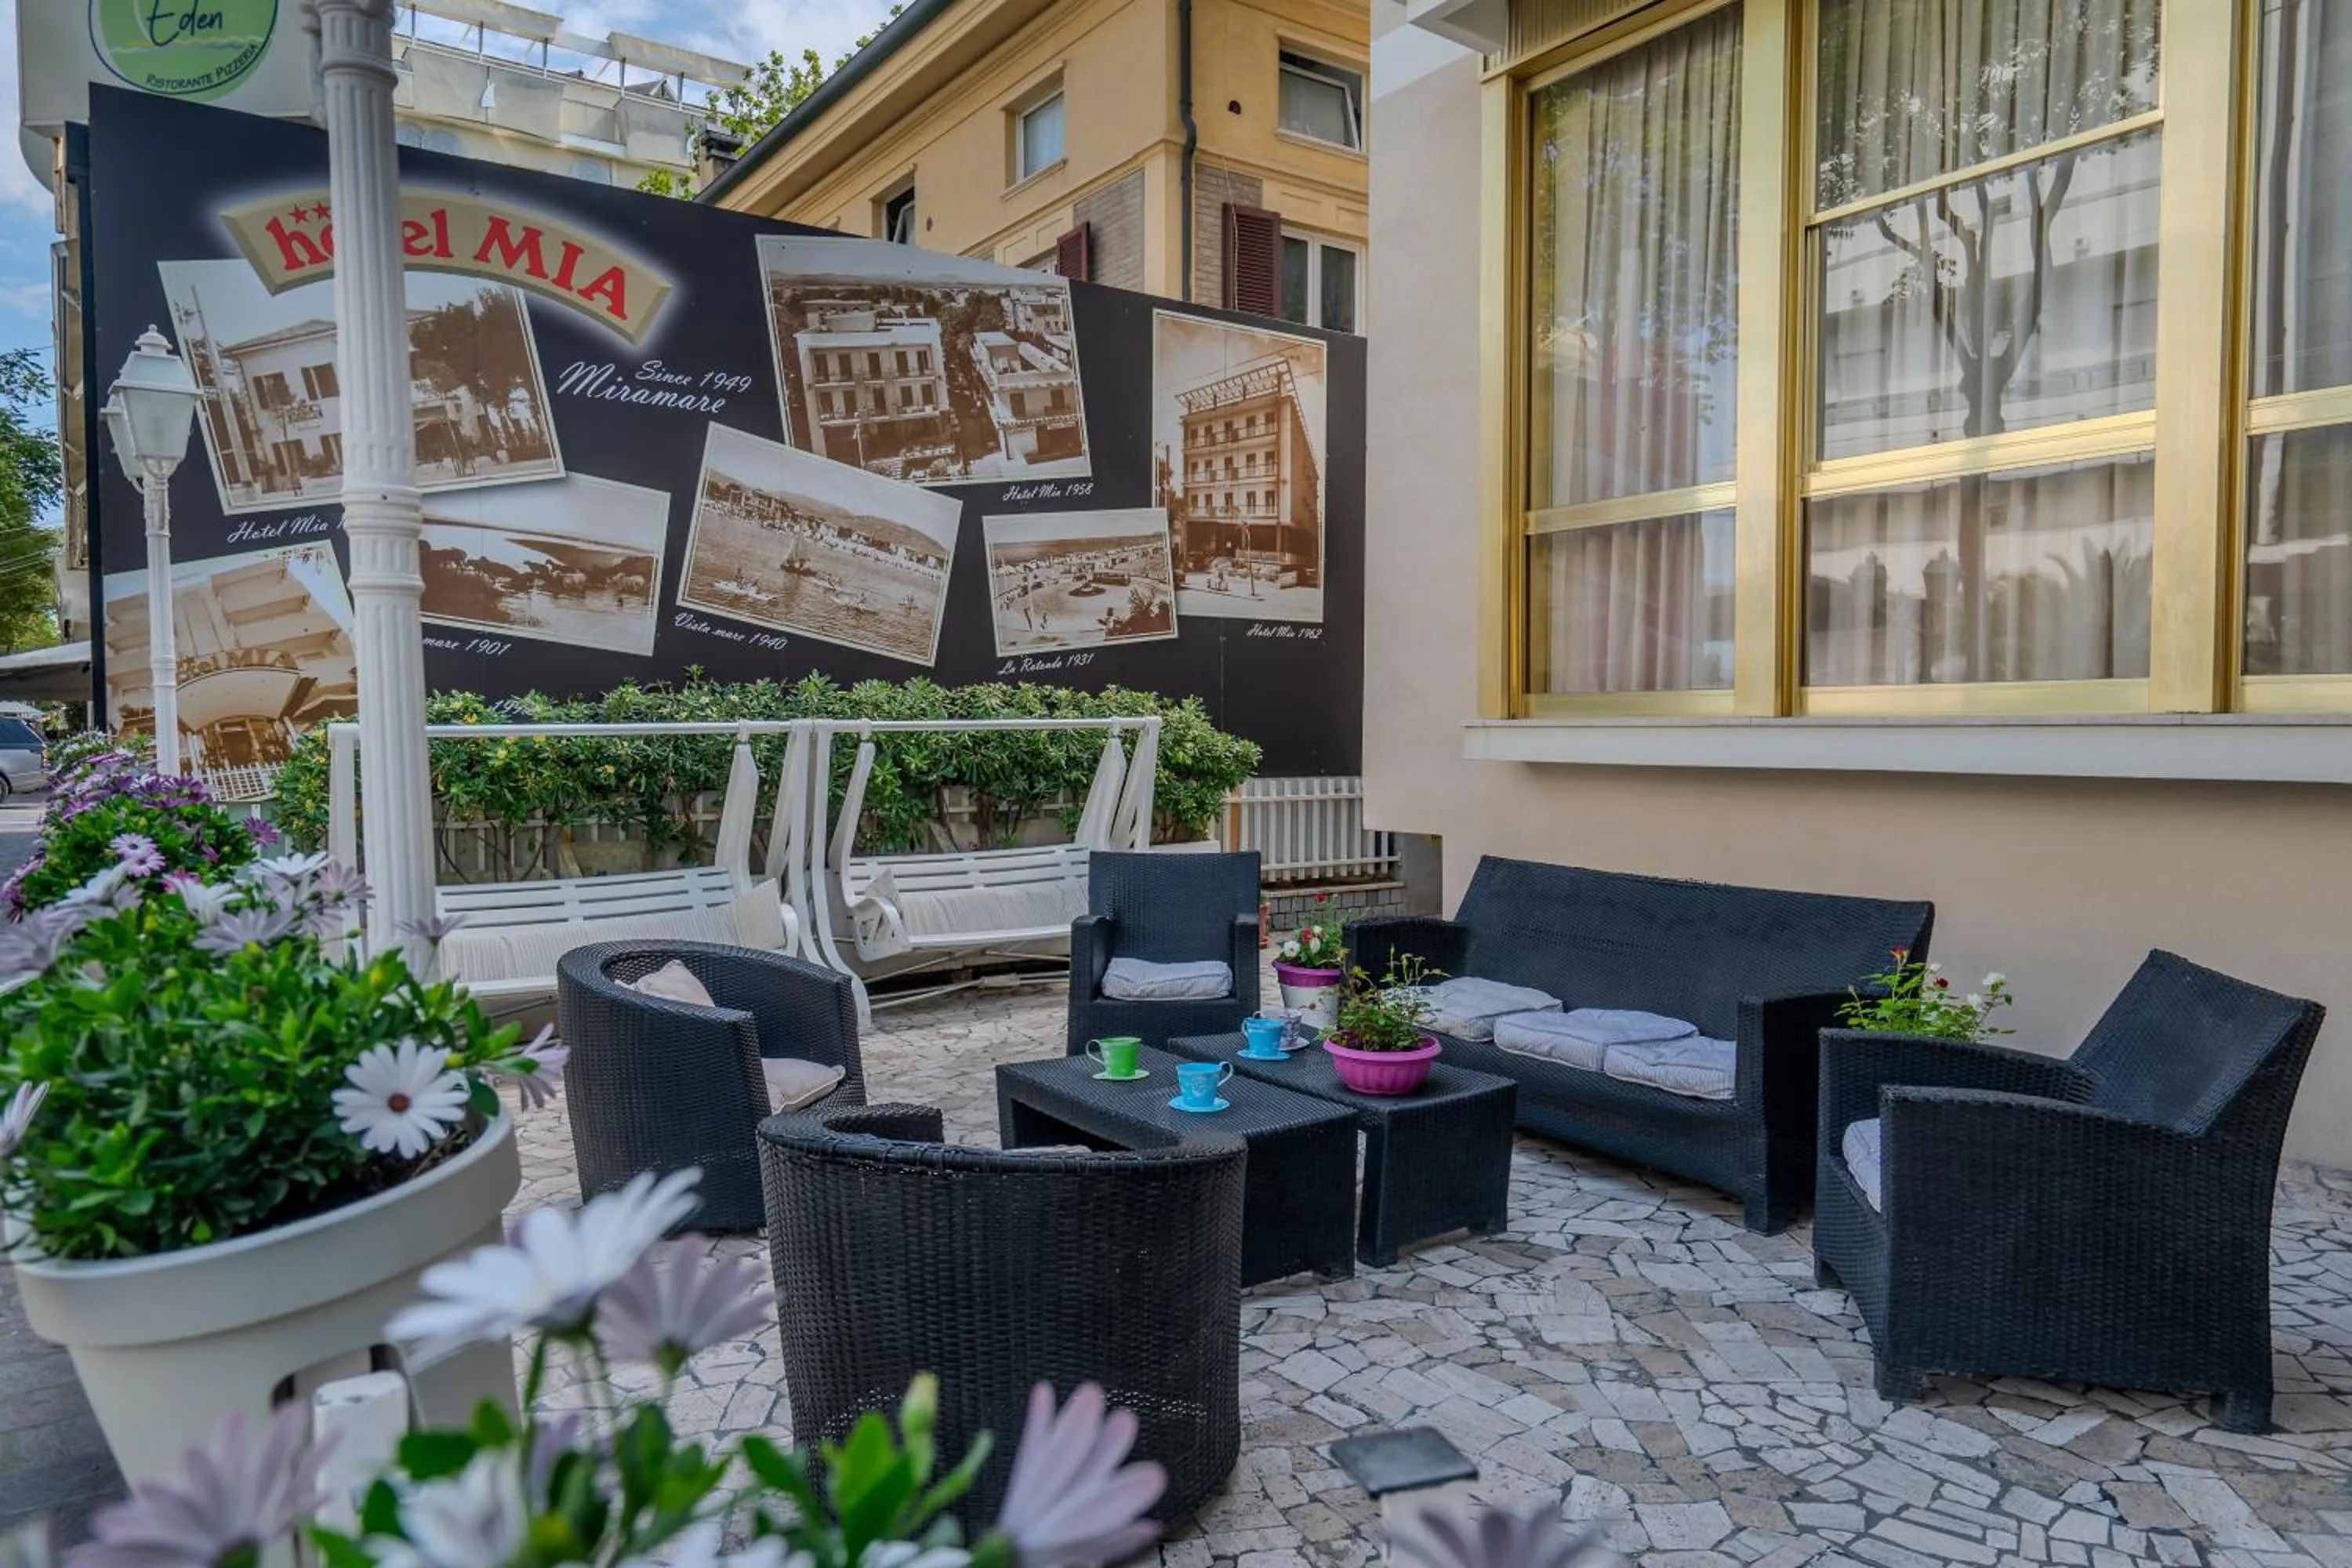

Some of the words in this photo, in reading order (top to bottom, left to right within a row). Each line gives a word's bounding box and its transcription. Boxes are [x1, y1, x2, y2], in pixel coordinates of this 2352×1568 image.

[146, 0, 223, 47] Eden
[264, 208, 455, 270] hel
[473, 215, 628, 321] MIA
[557, 361, 726, 413] Miramare
[635, 360, 692, 387] Since
[699, 371, 753, 393] 1949
[1065, 483, 1094, 495] 1958
[227, 519, 289, 543] Hotel
[290, 514, 329, 534] Mia
[465, 639, 512, 655] 1901
[749, 633, 788, 650] 1940
[1065, 652, 1095, 666] 1931
